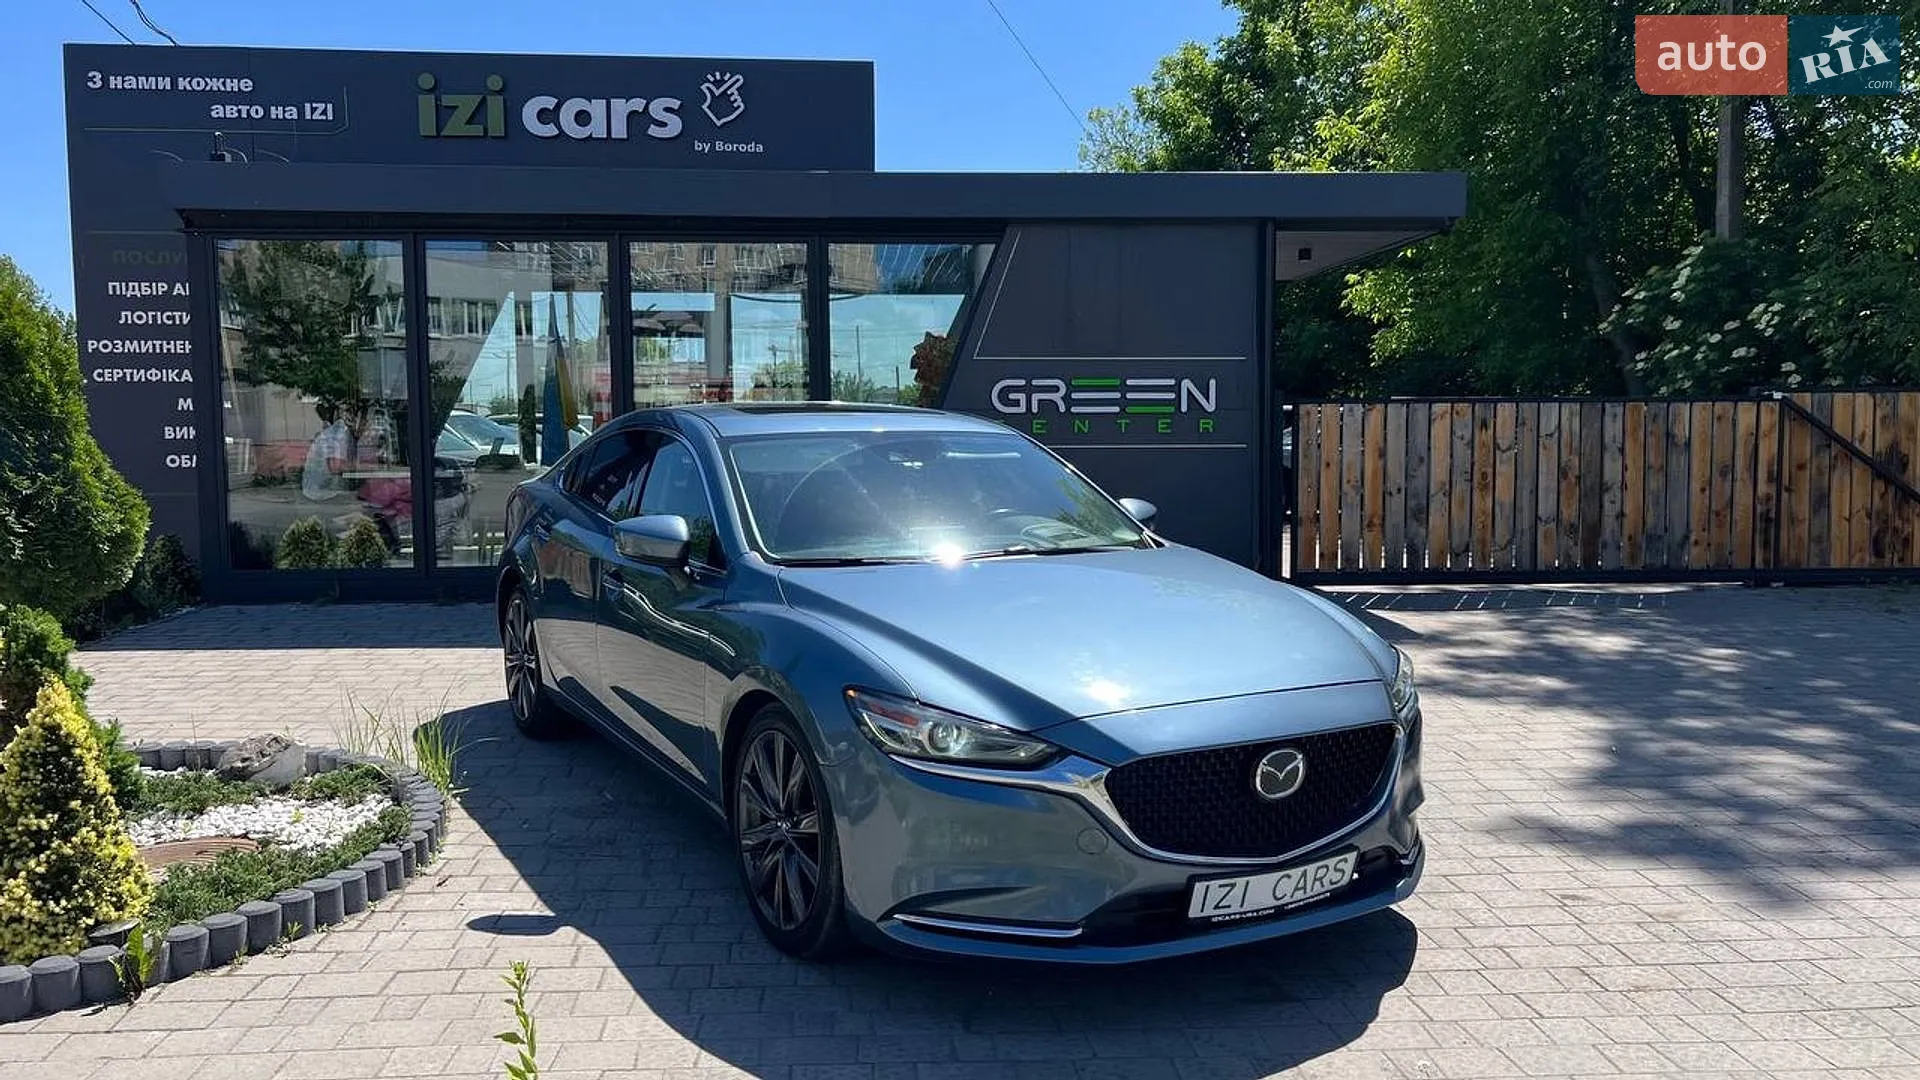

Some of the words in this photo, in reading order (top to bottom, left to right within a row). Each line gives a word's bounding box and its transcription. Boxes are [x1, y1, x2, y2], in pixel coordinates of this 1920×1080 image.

[109, 75, 171, 91] нами
[177, 77, 254, 92] кожне
[210, 103, 265, 119] авто
[270, 104, 298, 120] на
[304, 102, 334, 121] IZI
[418, 72, 506, 137] izi
[521, 95, 683, 139] cars
[694, 140, 711, 154] by
[715, 140, 764, 153] Boroda
[112, 249, 188, 265] ПОСЛУ
[108, 282, 168, 298] ПІДБІР
[92, 367, 193, 382] СЕРТИФІКА
[991, 378, 1217, 414] GREEN
[1000, 419, 1216, 434] ENTER
[1200, 880, 1250, 914] IZI
[1272, 857, 1348, 901] CARS
